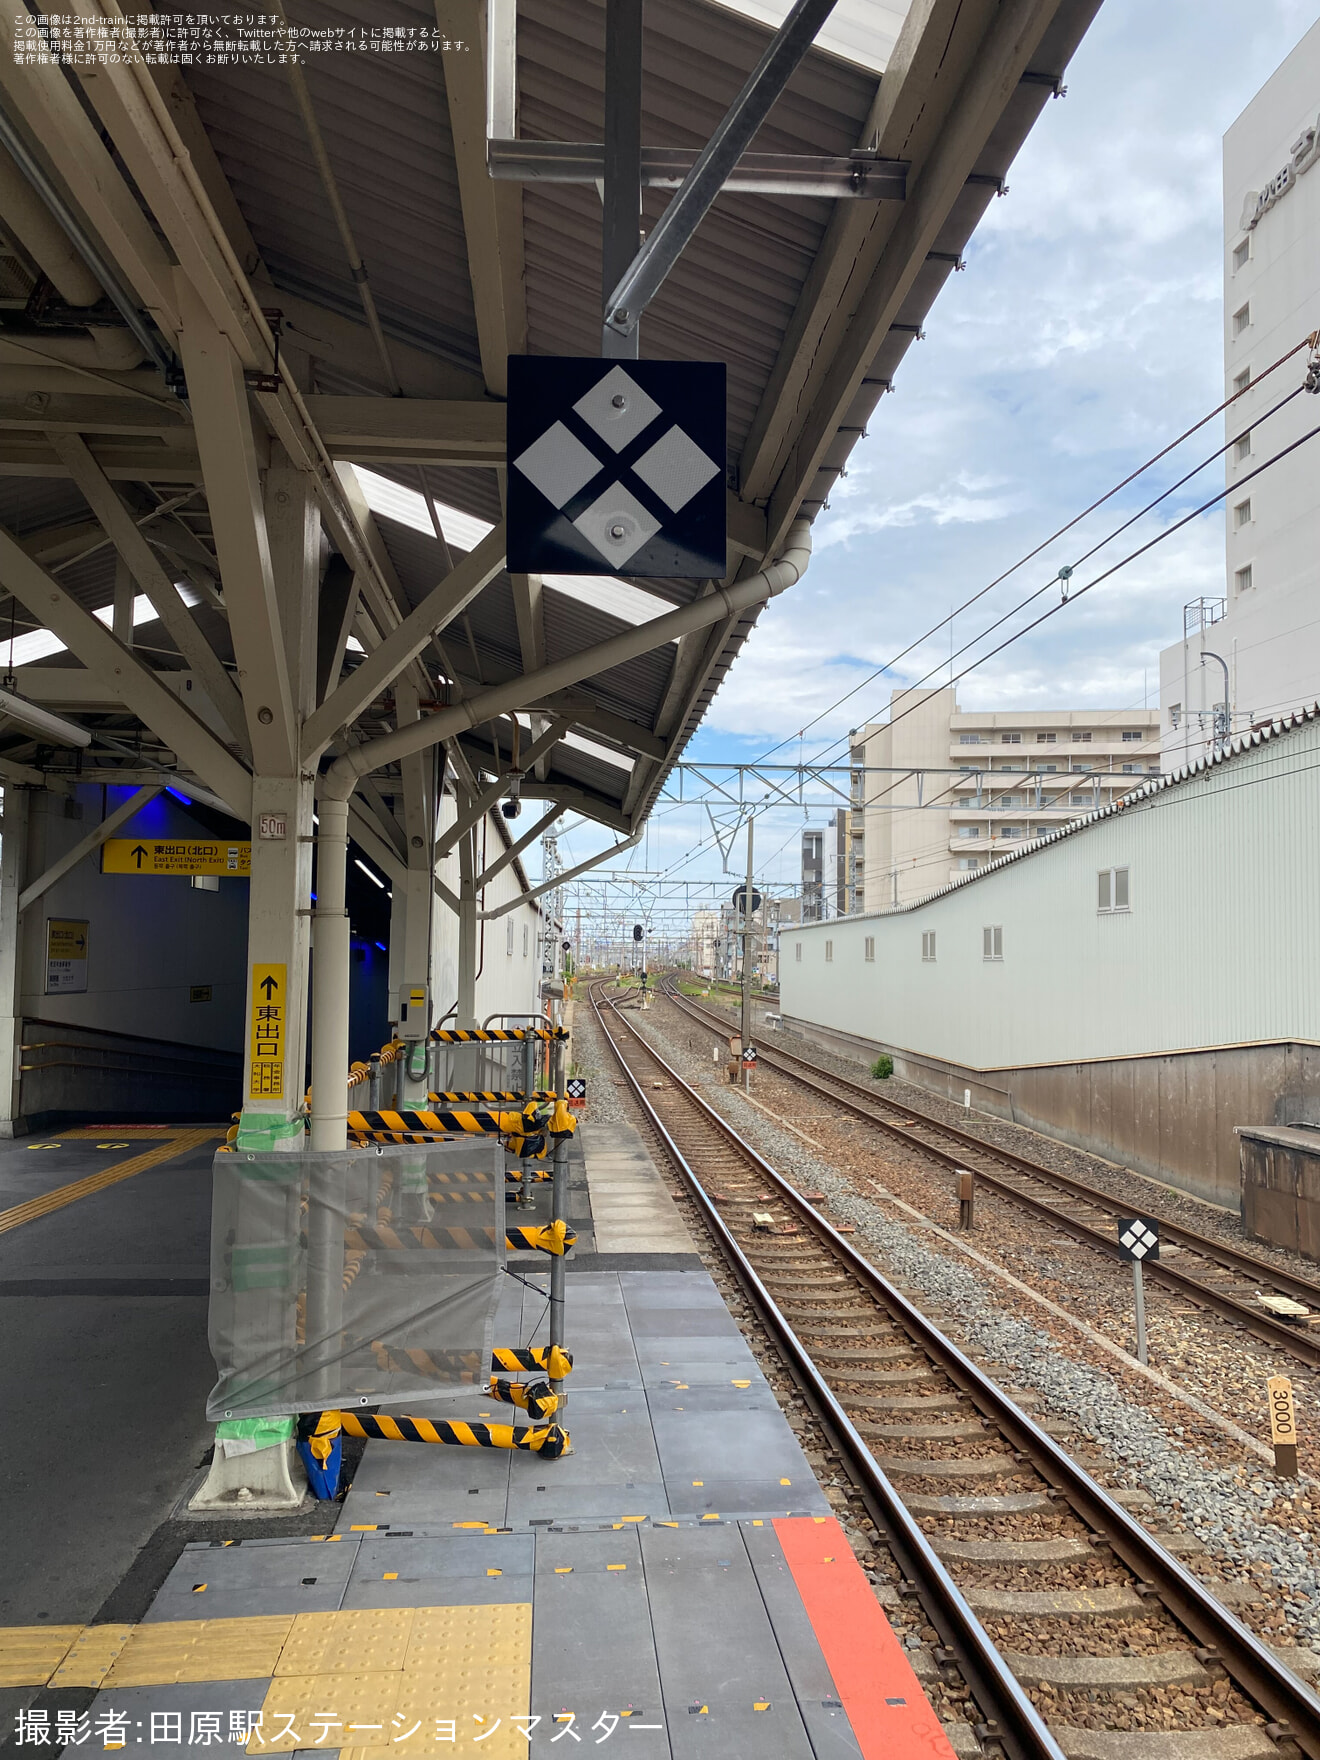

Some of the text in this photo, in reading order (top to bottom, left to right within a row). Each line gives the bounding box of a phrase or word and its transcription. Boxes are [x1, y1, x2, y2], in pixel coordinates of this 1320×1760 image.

[261, 818, 286, 835] 50m
[255, 1005, 281, 1056] 東出口
[1272, 1390, 1292, 1434] 3000
